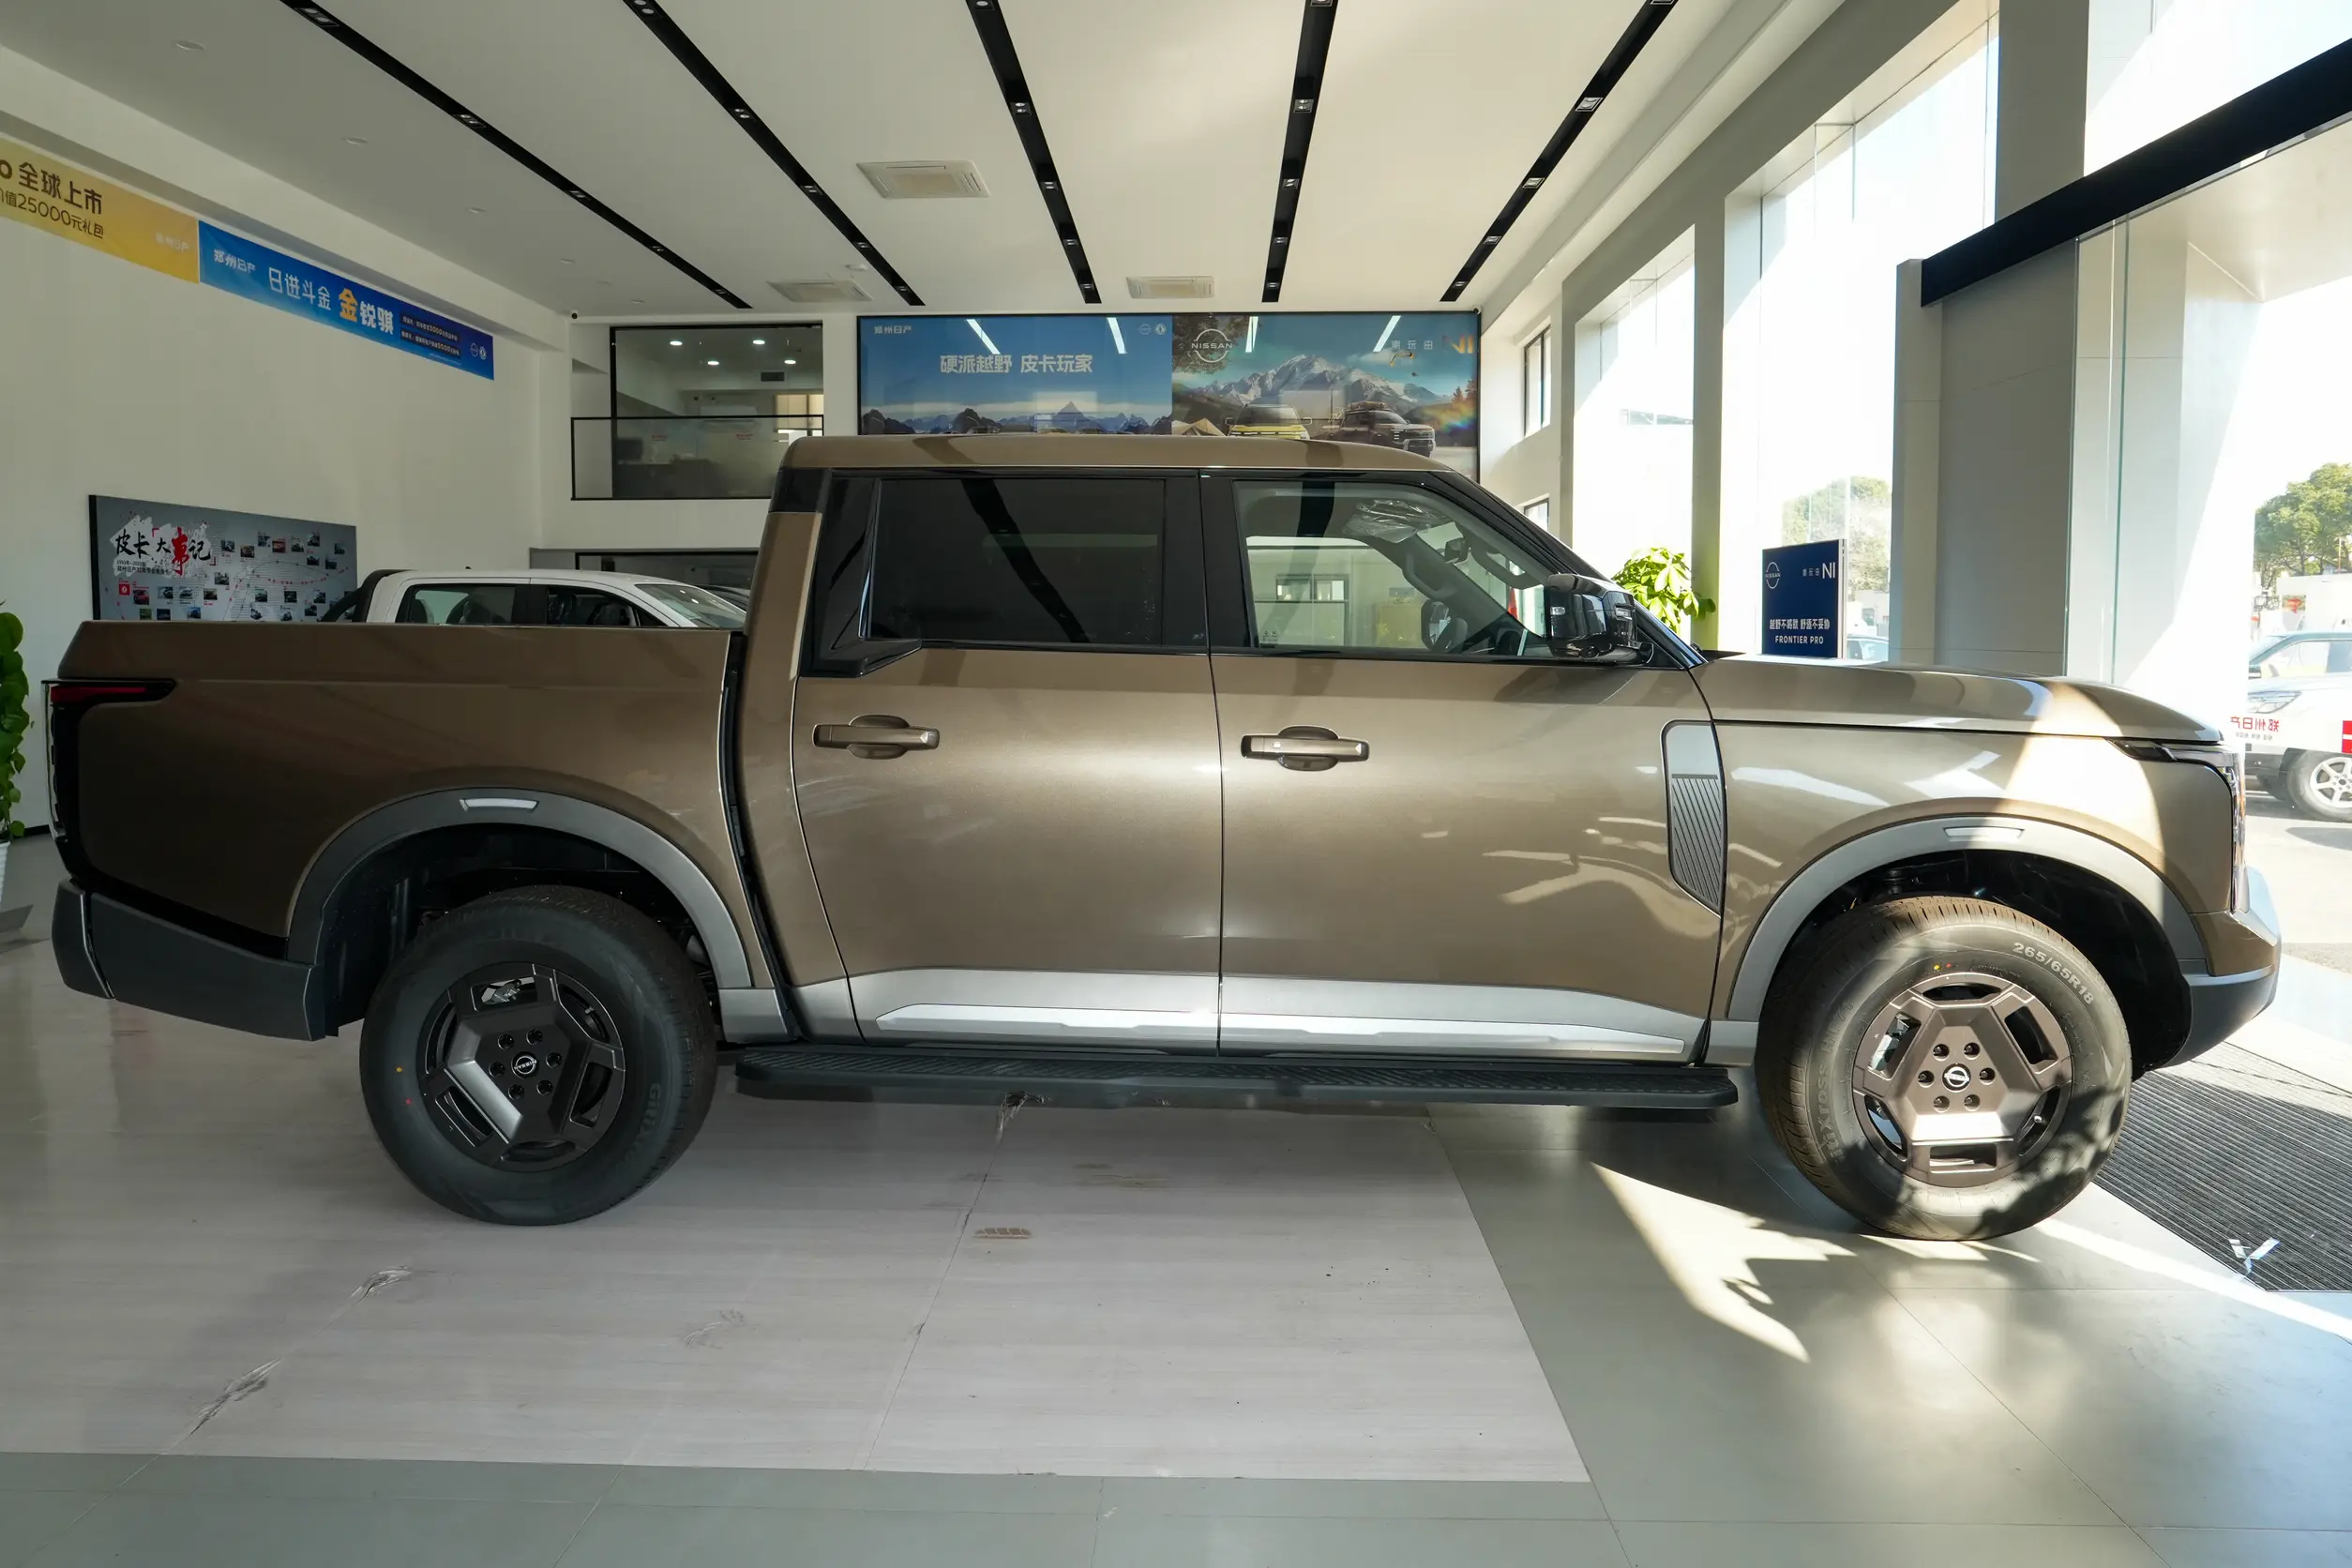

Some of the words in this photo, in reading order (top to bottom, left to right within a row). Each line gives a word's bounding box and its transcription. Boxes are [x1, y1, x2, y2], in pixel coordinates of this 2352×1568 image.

[19, 161, 102, 215] 全球上市
[214, 249, 256, 274] 郑州日产
[268, 266, 331, 311] 日进斗金
[339, 288, 394, 335] 金锐骐
[874, 324, 912, 335] 郑州日产
[1191, 341, 1233, 350] NISSAN
[940, 354, 1013, 374] 硬派越野
[1019, 354, 1093, 374] 皮卡玩家
[1822, 562, 1836, 579] NI
[1774, 635, 1808, 644] FRONTIER
[1810, 636, 1824, 645] PRO
[2013, 942, 2094, 1004] 265/65R18
